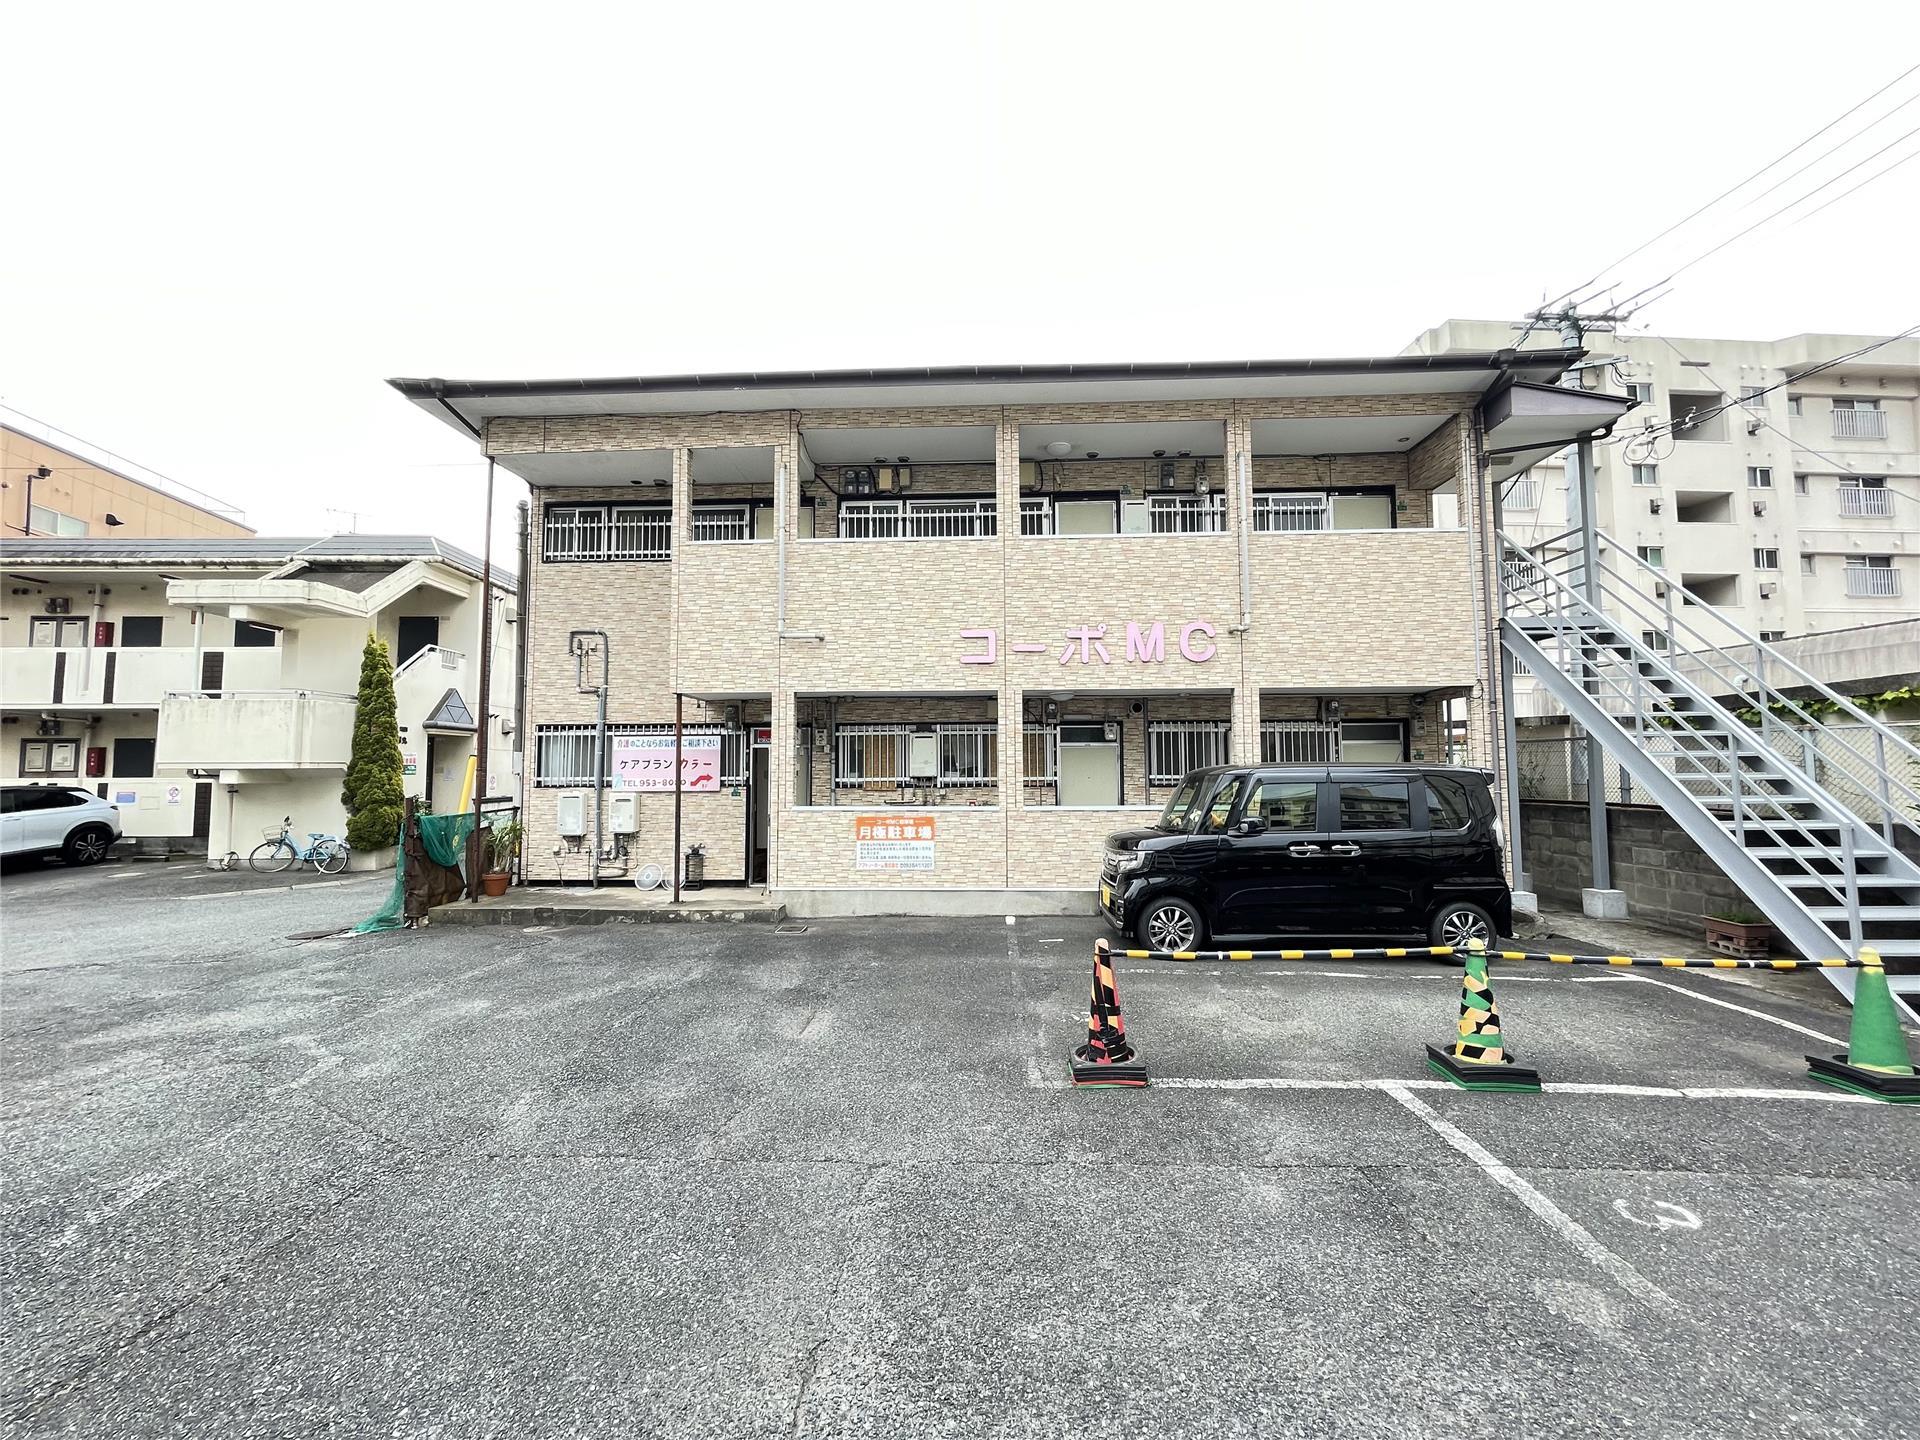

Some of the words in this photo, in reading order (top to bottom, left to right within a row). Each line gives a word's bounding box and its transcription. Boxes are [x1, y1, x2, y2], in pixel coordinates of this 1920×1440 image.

[617, 738, 719, 749] 介護のことならお気軽ご相談下さい
[639, 779, 687, 788] 953-800
